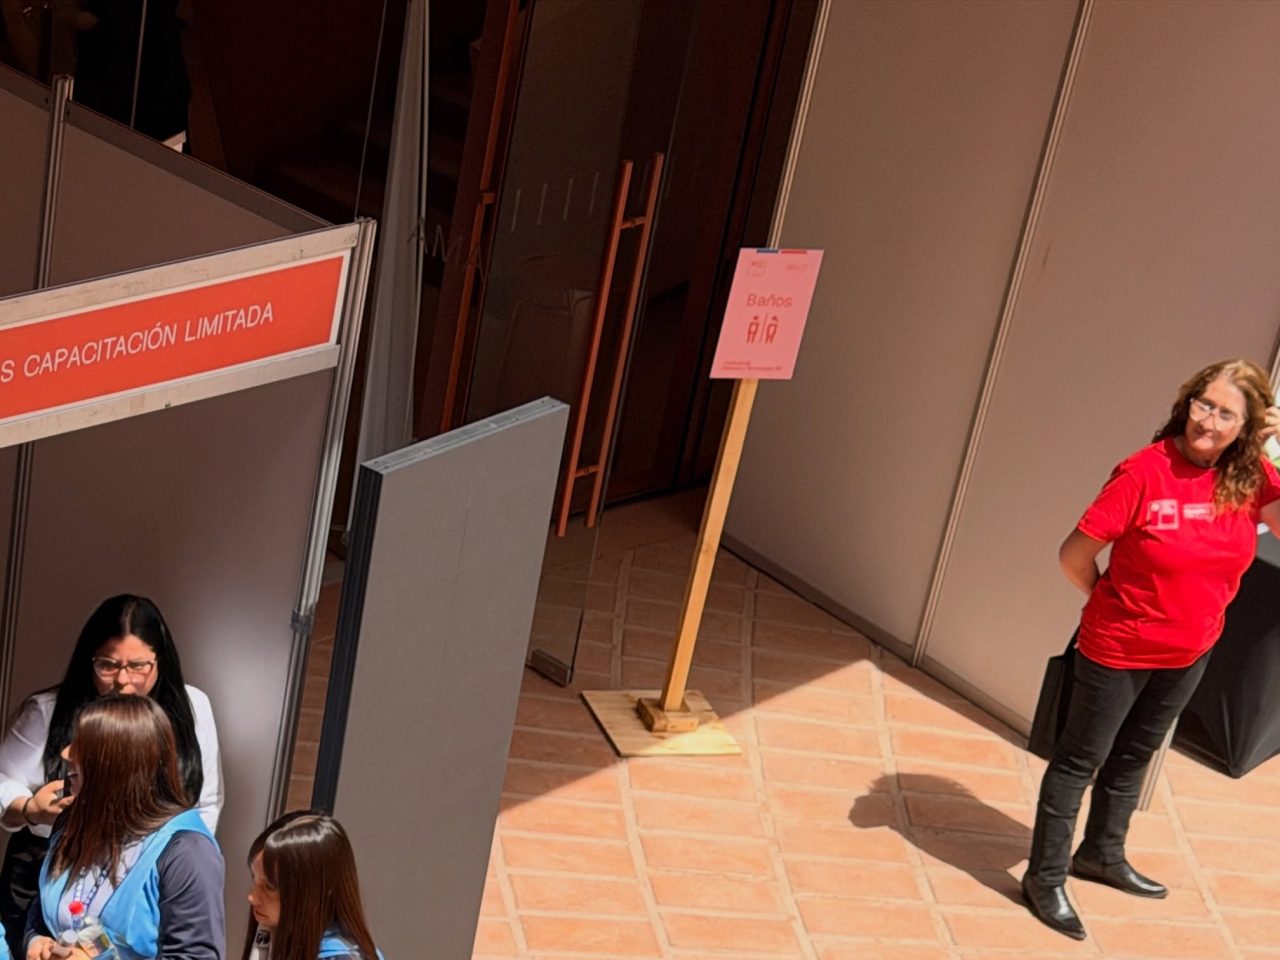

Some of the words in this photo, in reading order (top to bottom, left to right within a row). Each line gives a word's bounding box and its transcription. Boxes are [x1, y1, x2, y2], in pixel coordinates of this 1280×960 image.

[746, 293, 793, 308] Baños
[23, 321, 177, 377] CAPACITACIÓN
[184, 301, 274, 344] LIMITADA
